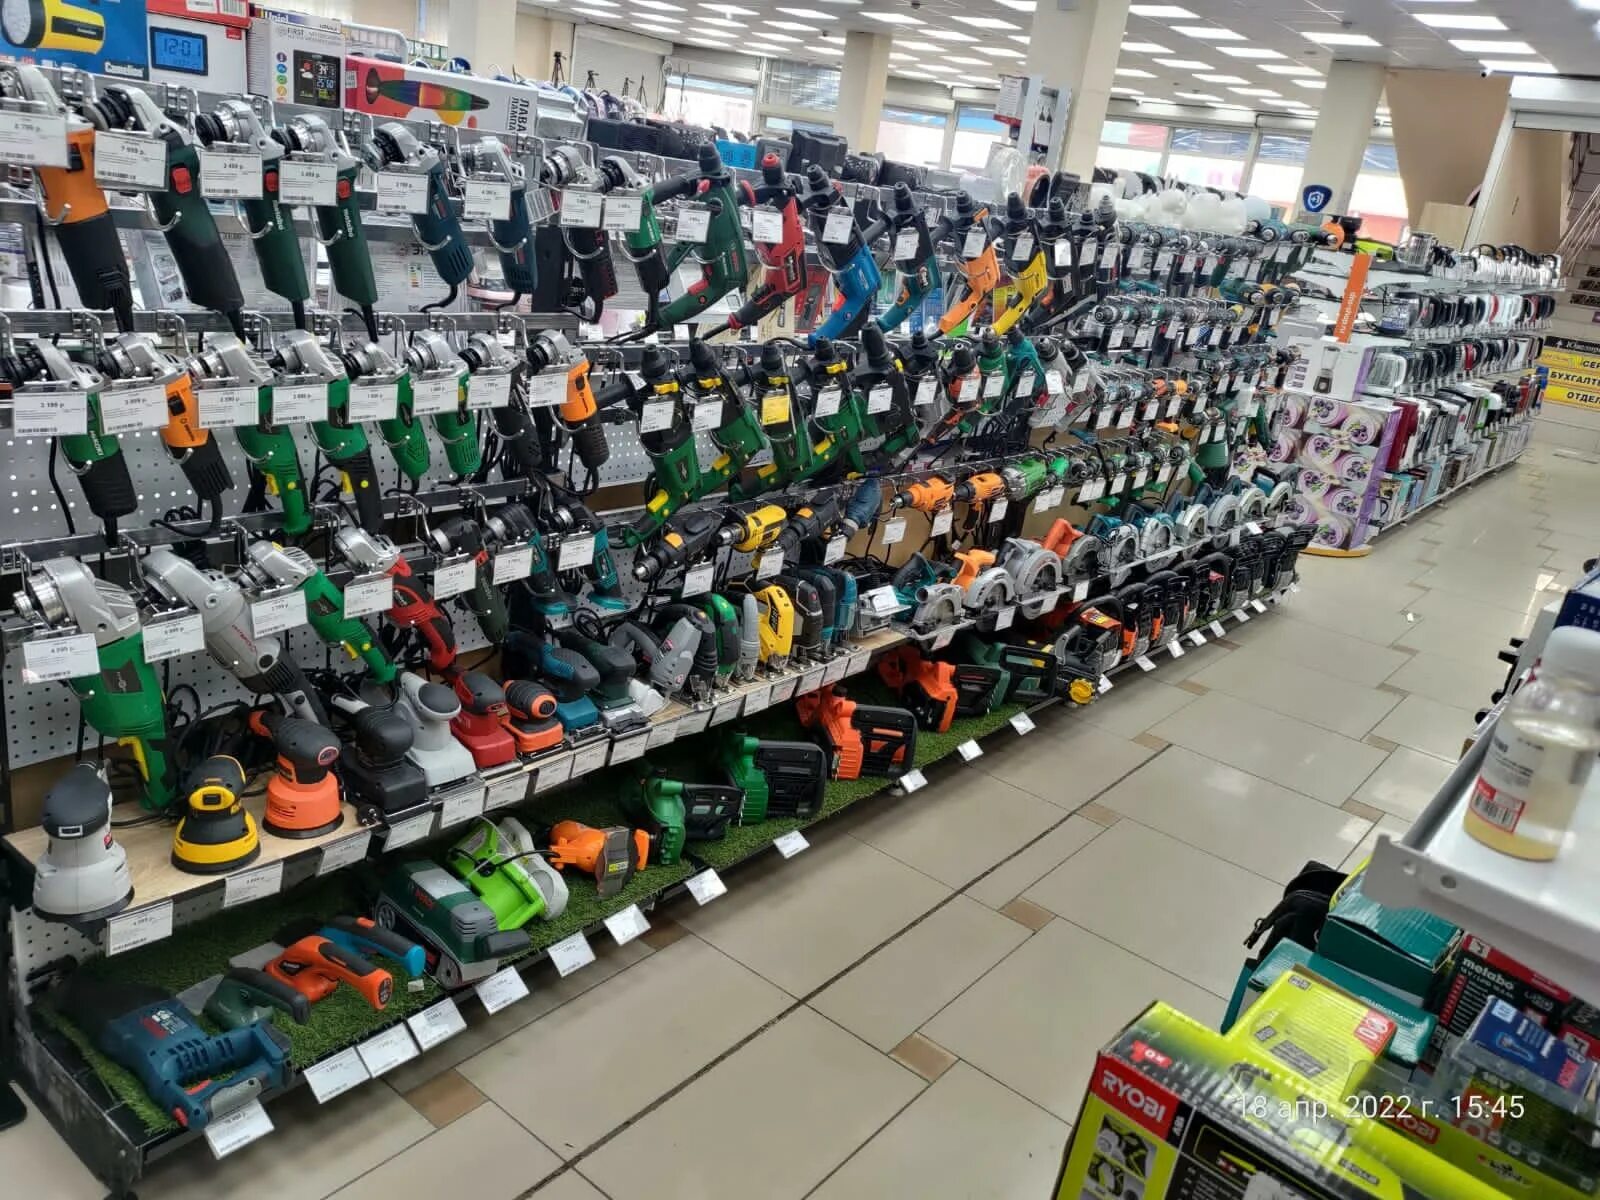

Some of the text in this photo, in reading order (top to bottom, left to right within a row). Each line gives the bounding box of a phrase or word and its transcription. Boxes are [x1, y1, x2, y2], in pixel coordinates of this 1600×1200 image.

[517, 98, 529, 131] ЛАВА
[1463, 957, 1514, 990] metabo
[1102, 1070, 1167, 1122] RYOBI
